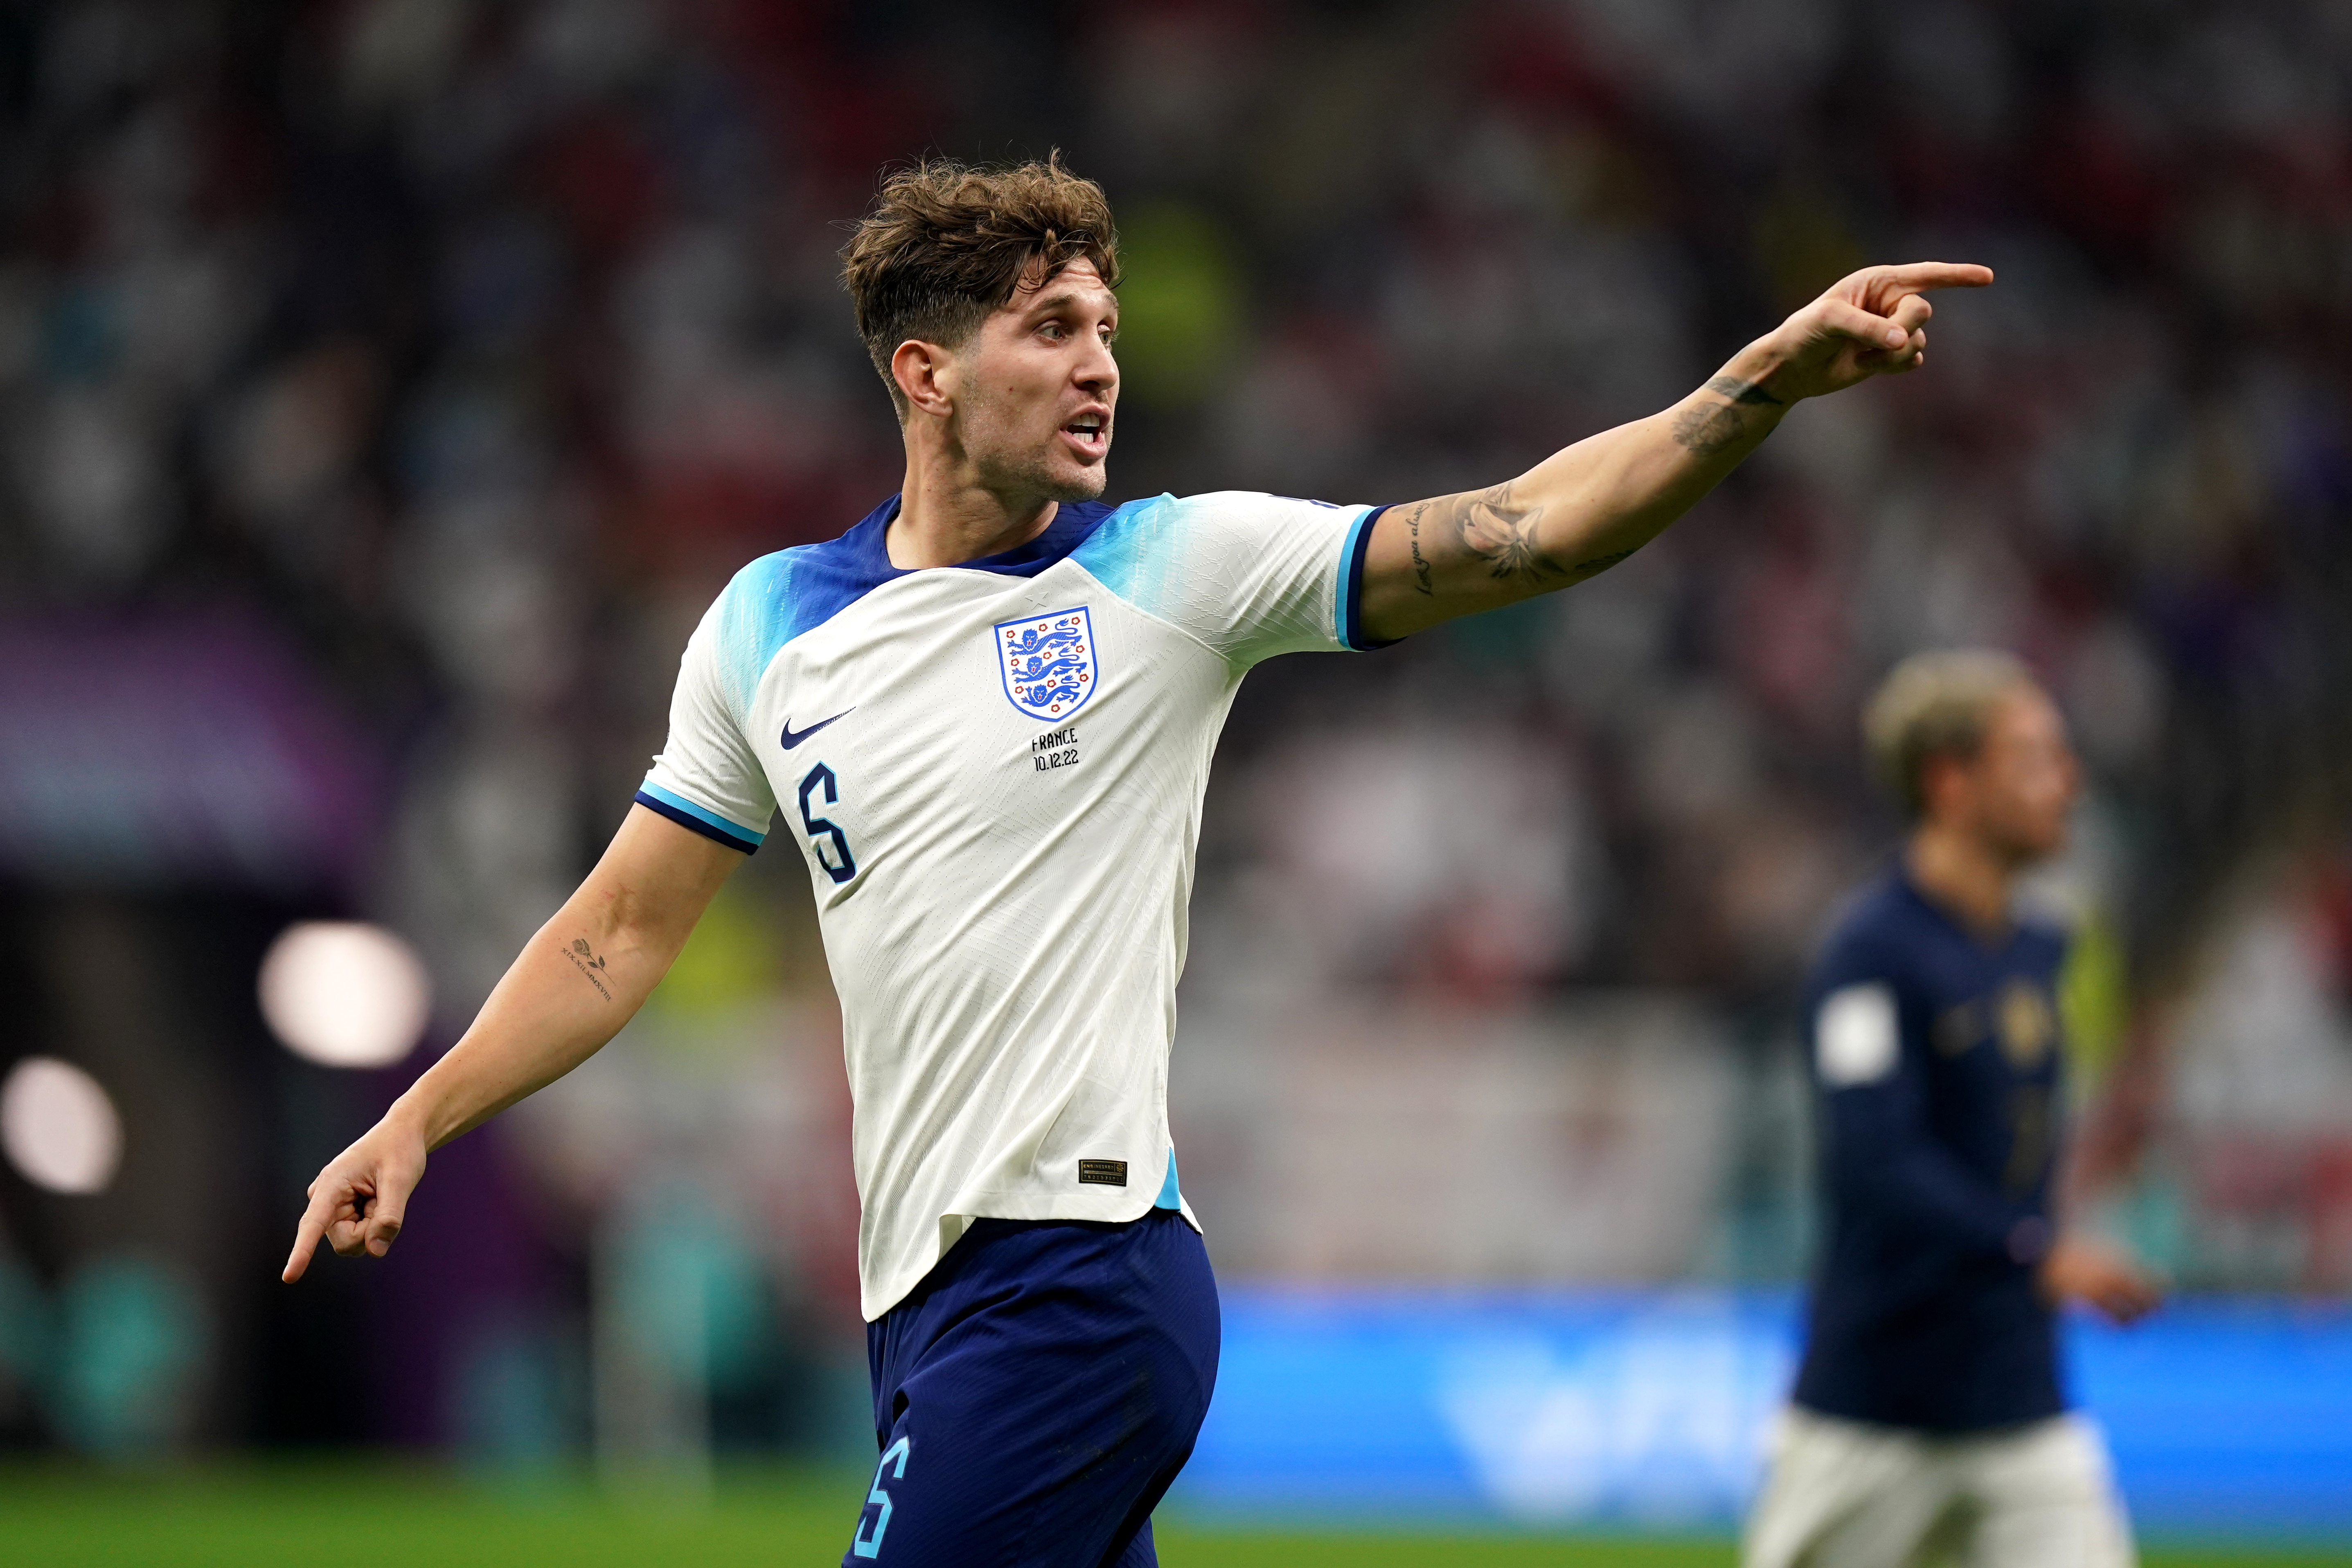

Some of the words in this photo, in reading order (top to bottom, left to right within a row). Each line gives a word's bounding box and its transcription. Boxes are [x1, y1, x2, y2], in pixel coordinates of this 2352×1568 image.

[1032, 728, 1077, 752] FRANCE
[1033, 749, 1079, 772] 10.12.22
[798, 760, 857, 885] 5
[854, 1435, 911, 1560] 5
